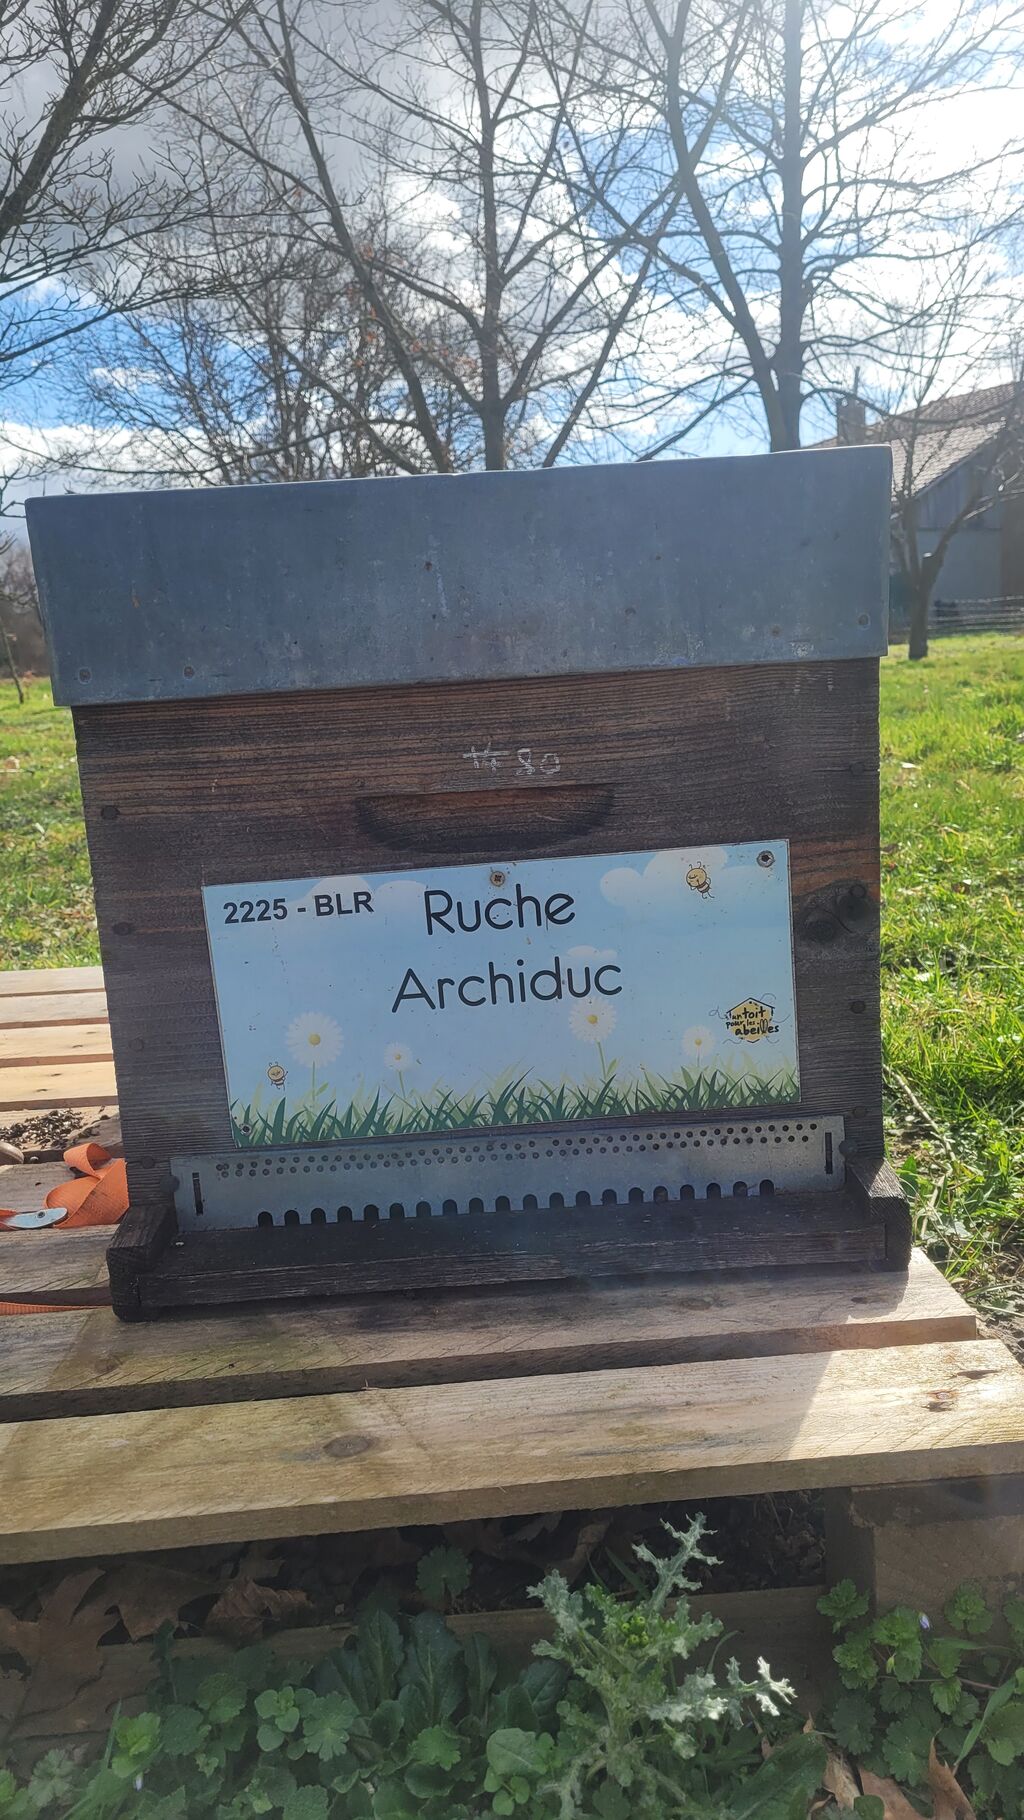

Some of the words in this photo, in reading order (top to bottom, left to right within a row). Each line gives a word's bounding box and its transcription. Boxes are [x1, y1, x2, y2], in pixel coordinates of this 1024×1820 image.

[223, 898, 288, 924] 2225
[314, 891, 374, 917] BLR
[424, 883, 576, 936] Ruche
[391, 956, 623, 1013] Archiduc
[725, 1020, 745, 1030] pour
[746, 1019, 756, 1027] les
[742, 1005, 767, 1020] toit
[734, 1018, 780, 1036] abeilles
